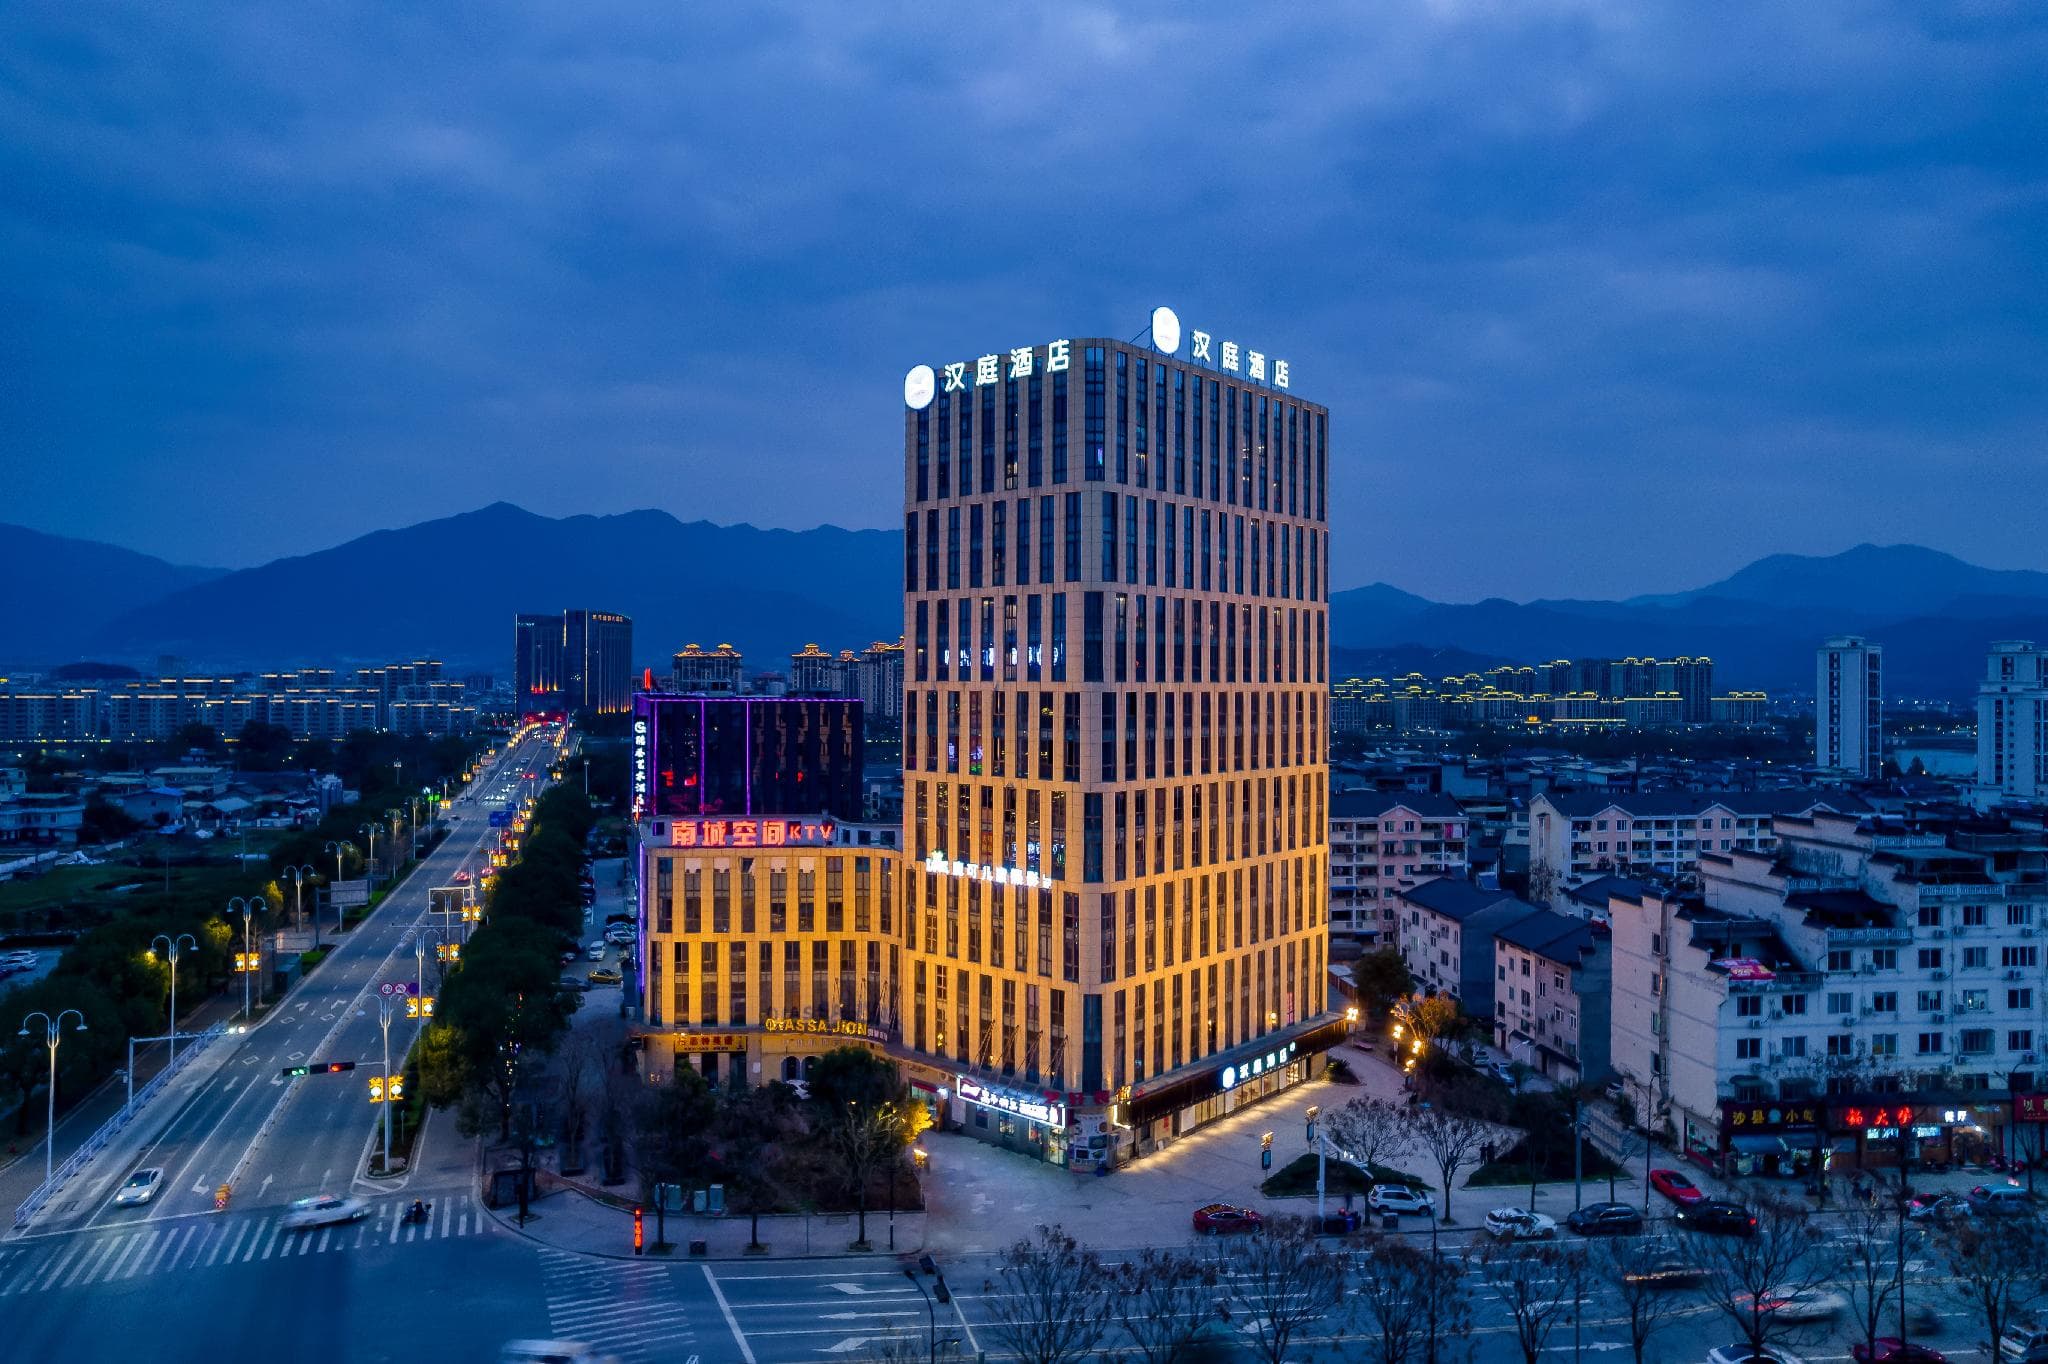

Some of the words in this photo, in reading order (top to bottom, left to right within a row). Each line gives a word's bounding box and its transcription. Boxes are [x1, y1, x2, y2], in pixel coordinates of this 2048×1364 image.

[945, 339, 1070, 392] 汉庭酒店
[1193, 329, 1289, 388] 汉庭酒店
[671, 820, 786, 846] 南城空间
[789, 824, 833, 841] KTV
